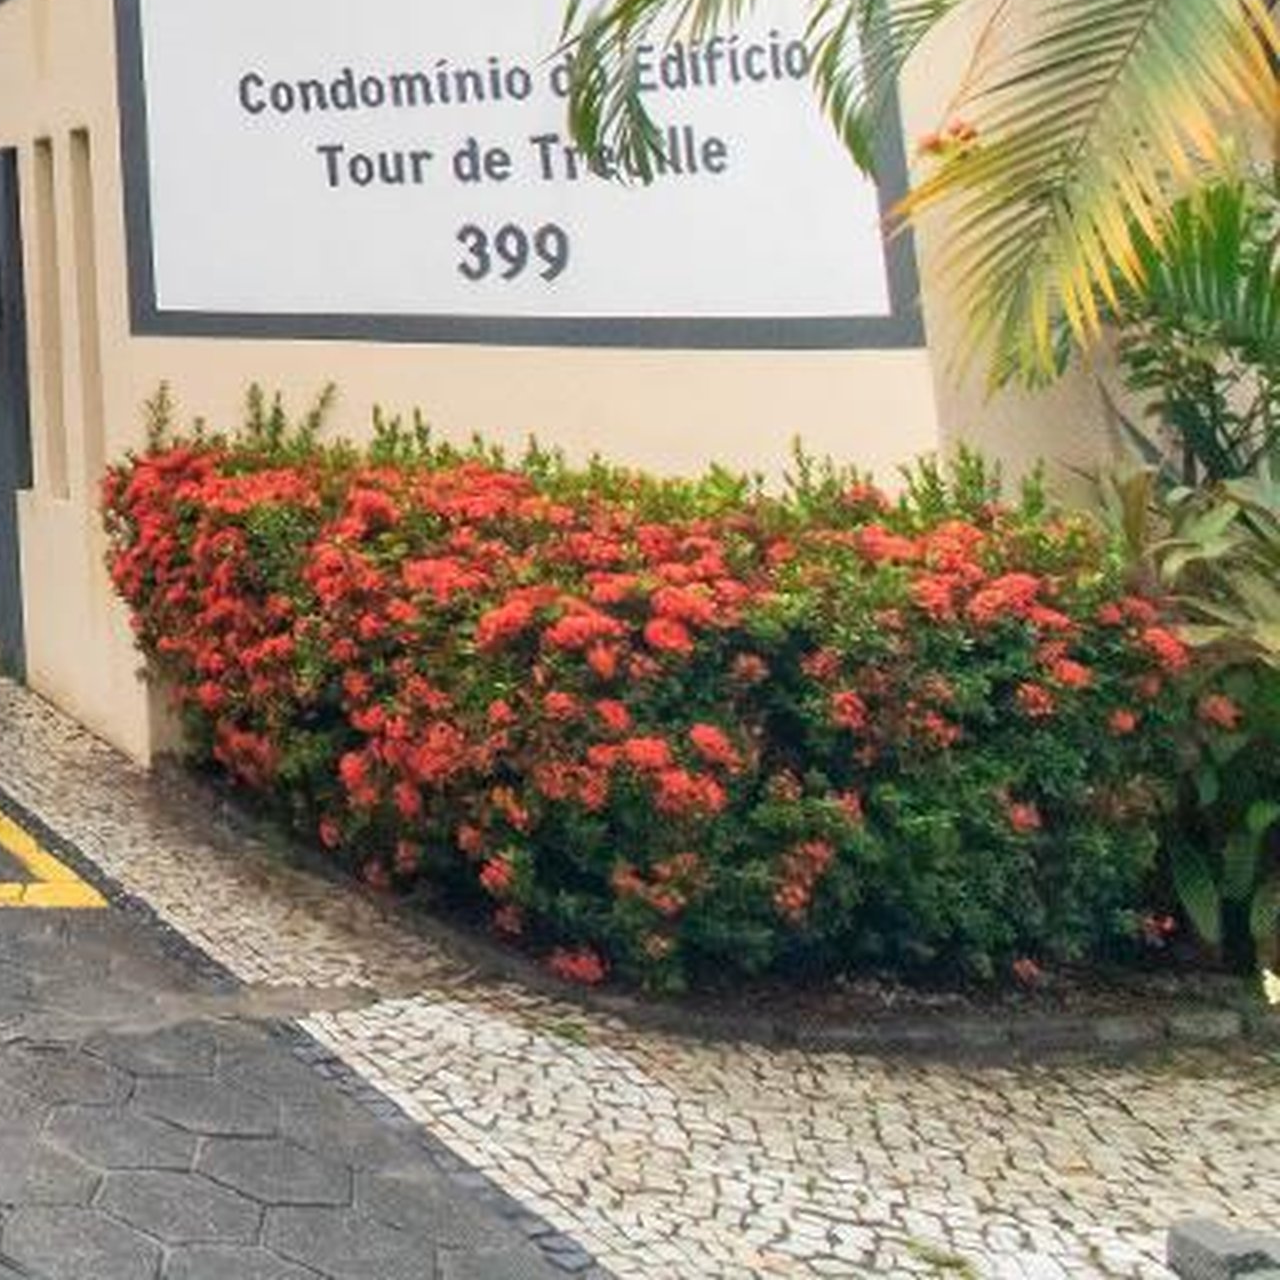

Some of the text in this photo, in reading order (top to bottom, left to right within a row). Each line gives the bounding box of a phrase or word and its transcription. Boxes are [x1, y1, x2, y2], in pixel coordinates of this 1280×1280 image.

[239, 55, 532, 114] Condomínio
[635, 28, 809, 91] Edifício
[316, 144, 433, 187] Tour
[452, 136, 513, 182] de
[456, 222, 569, 281] 399
